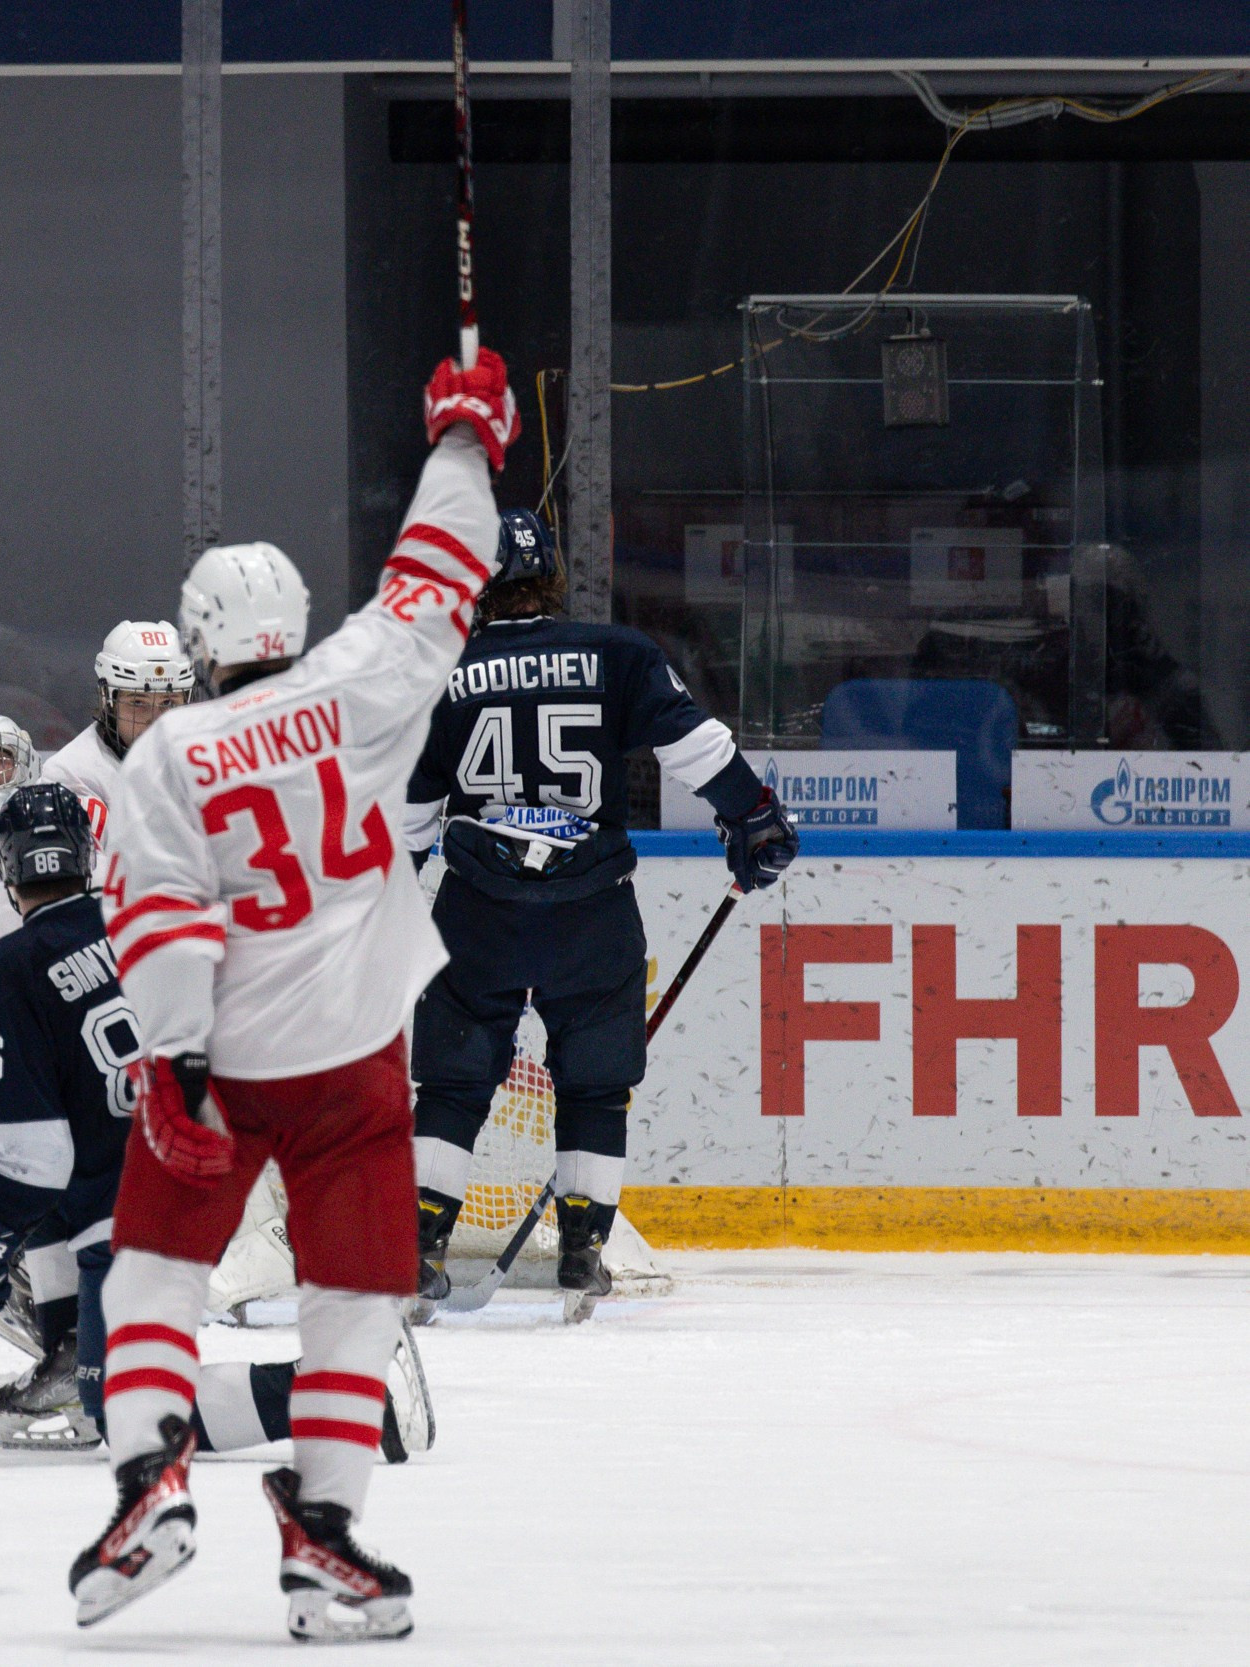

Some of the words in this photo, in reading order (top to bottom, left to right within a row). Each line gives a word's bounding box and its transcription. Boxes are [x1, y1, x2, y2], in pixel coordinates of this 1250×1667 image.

[457, 219, 472, 301] CCM
[515, 529, 536, 548] 45
[141, 631, 168, 646] 80
[255, 631, 285, 660] 34
[447, 653, 598, 703] RODICHEV
[186, 697, 342, 787] SAVIKOV
[456, 703, 602, 818] 45
[782, 776, 878, 801] ГАЗПРОМ
[34, 852, 60, 874] 86
[201, 756, 393, 933] 34
[103, 852, 127, 907] 4
[48, 936, 119, 1003] SINY
[760, 924, 1243, 1117] FHR
